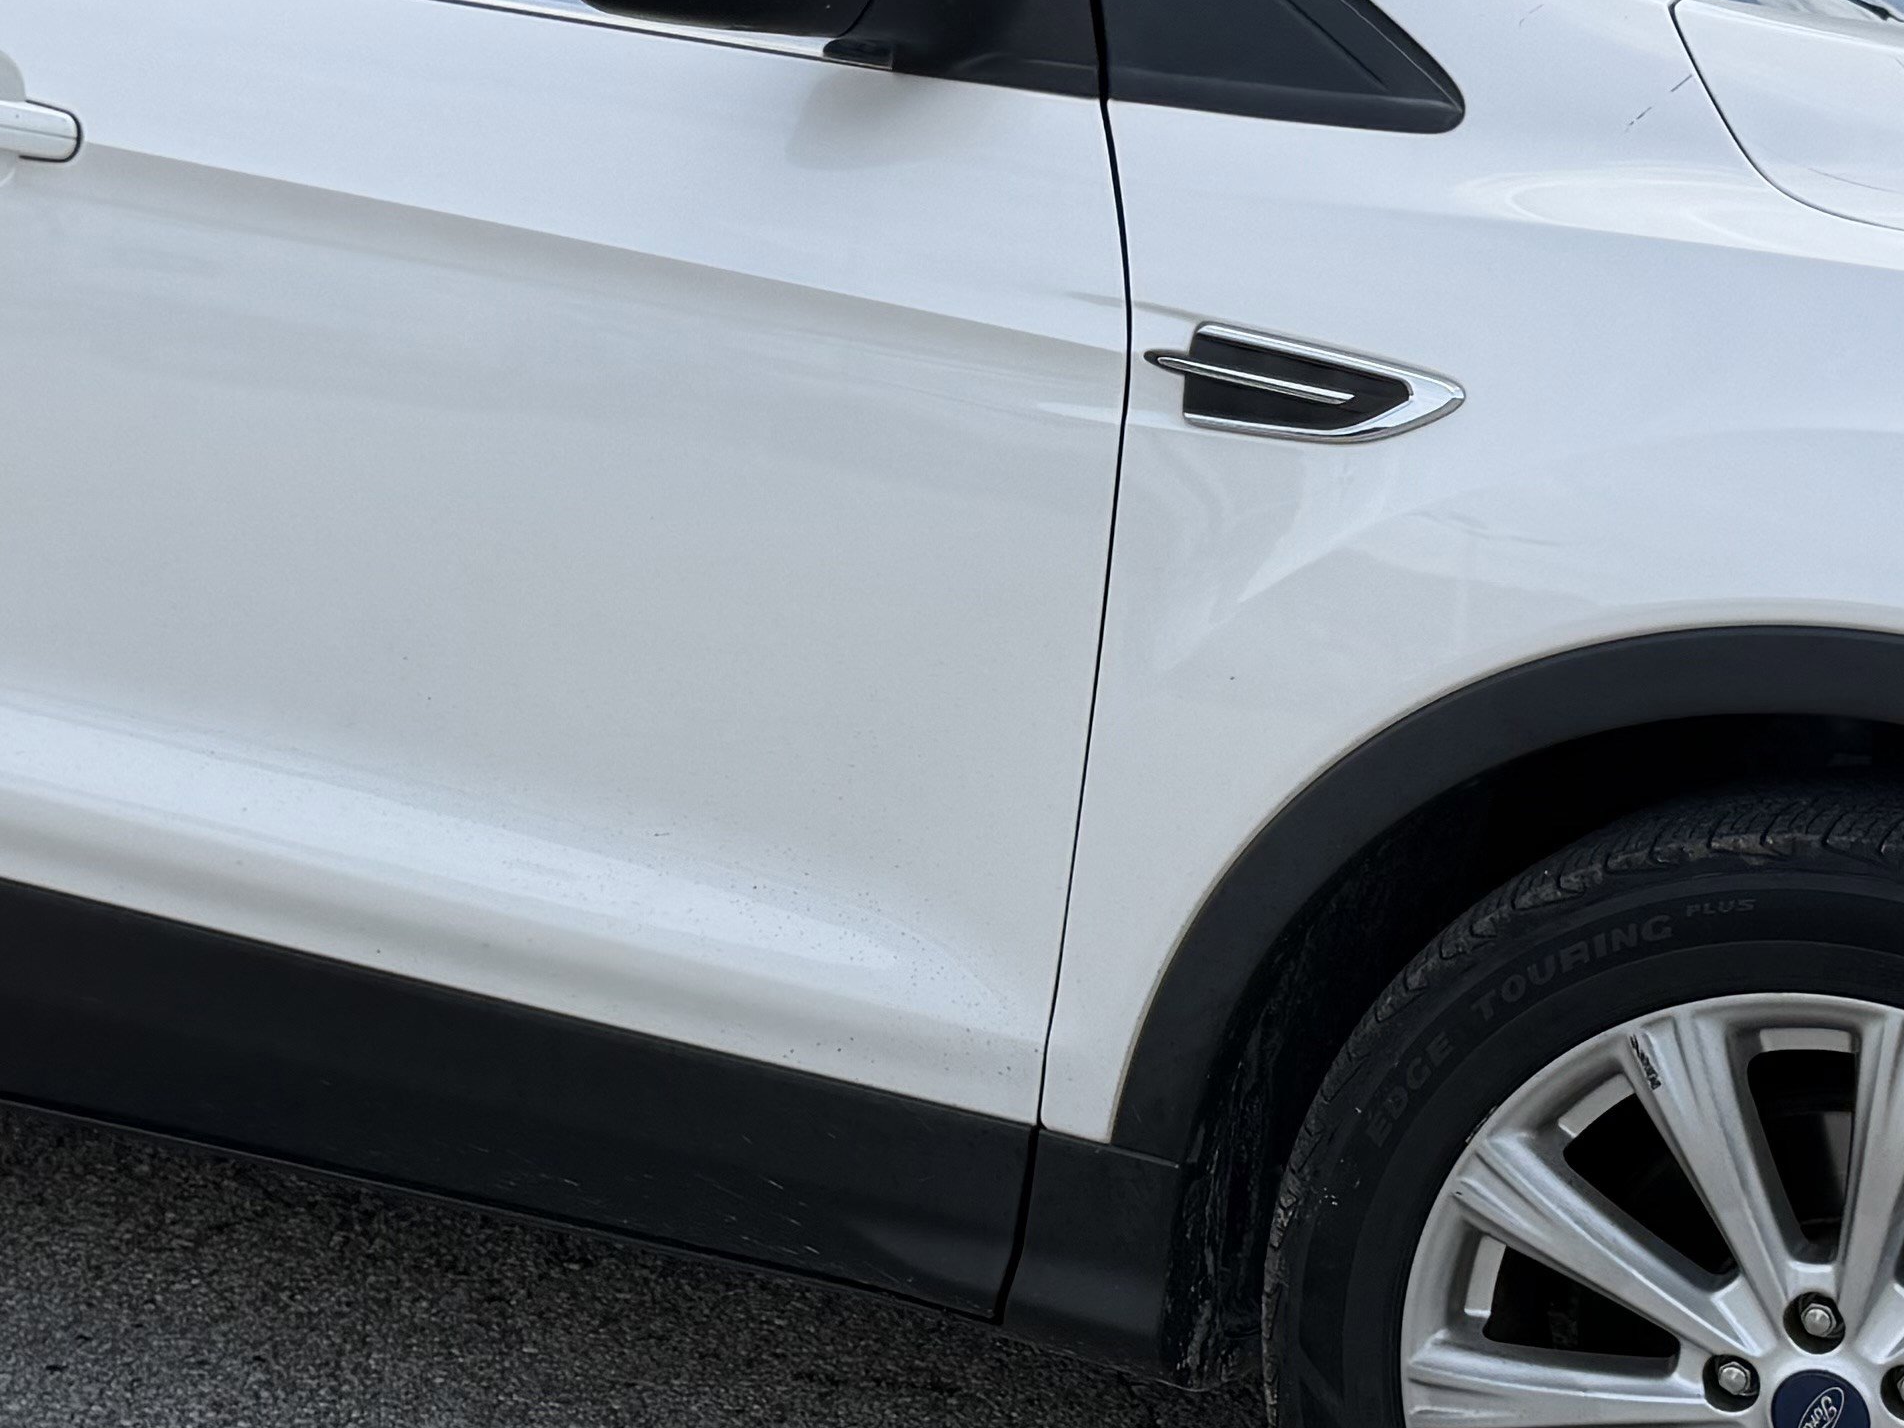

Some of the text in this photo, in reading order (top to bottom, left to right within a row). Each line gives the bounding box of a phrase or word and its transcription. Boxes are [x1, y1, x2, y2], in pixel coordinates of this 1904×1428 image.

[1364, 897, 1759, 1148] EDGE TOURING PLUS
